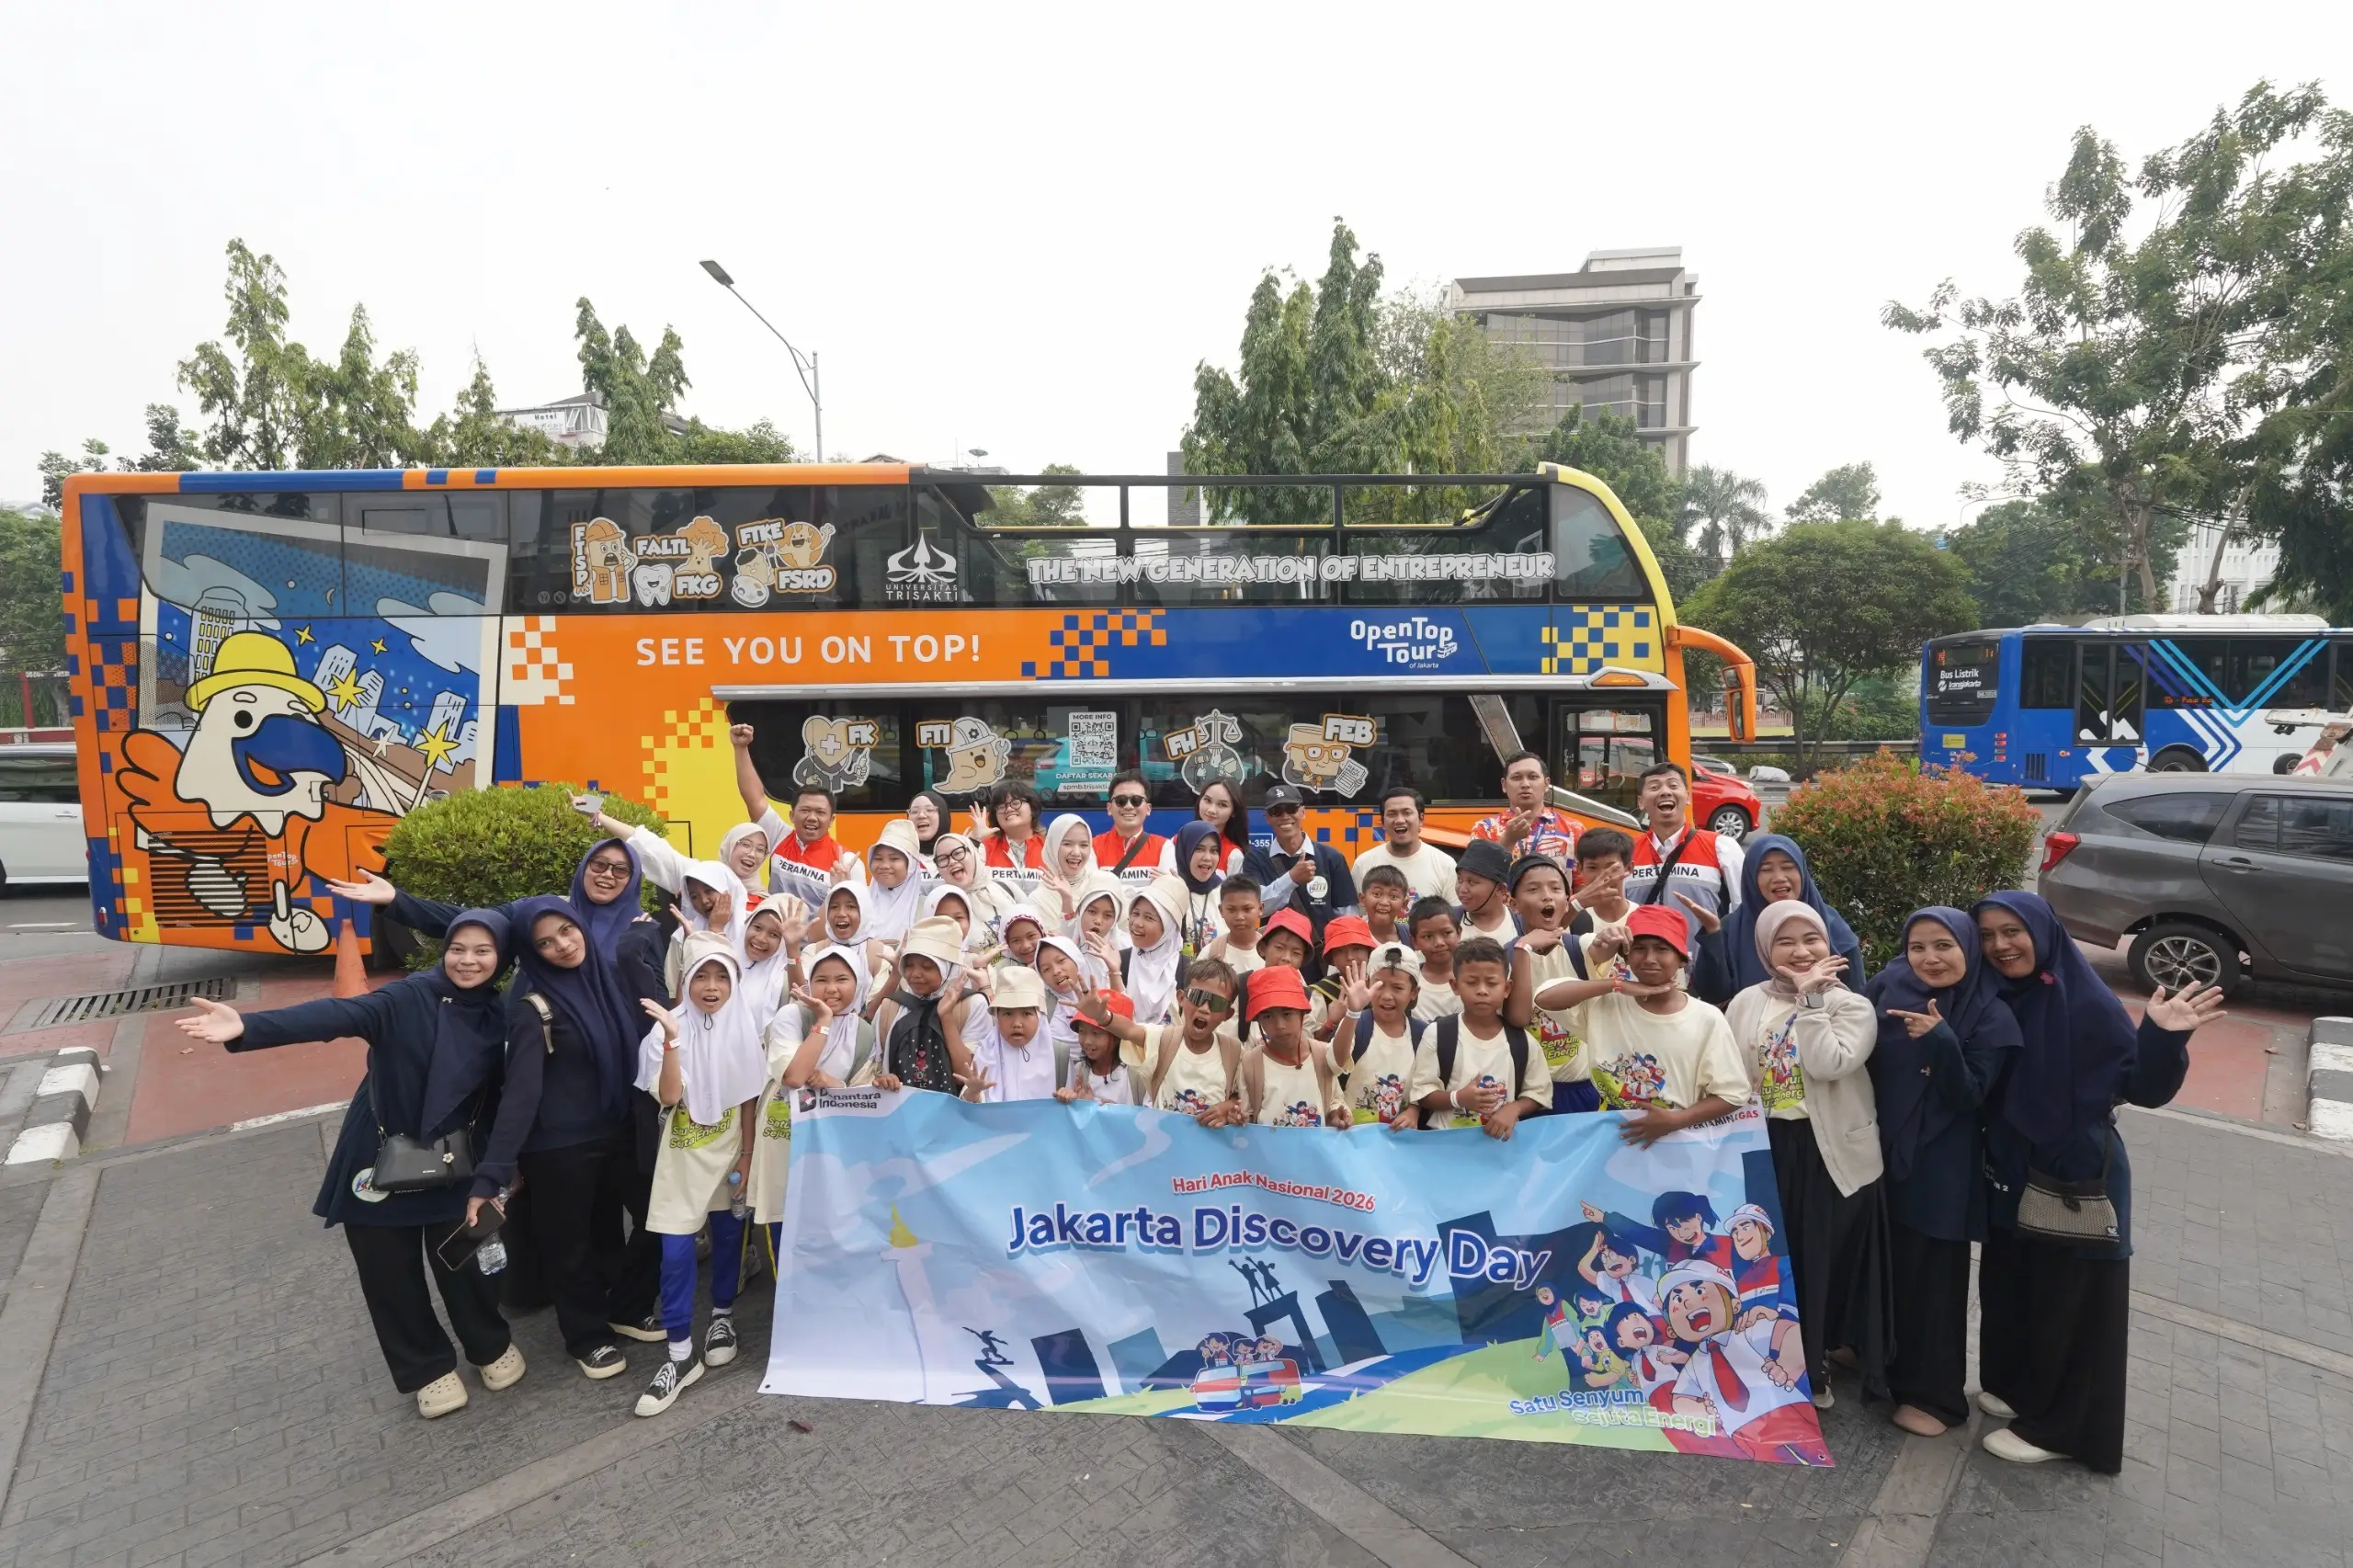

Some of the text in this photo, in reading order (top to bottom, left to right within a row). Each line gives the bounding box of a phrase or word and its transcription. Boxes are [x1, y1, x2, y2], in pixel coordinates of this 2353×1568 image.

[534, 413, 557, 421] Hotel
[739, 521, 784, 545] FTKE
[574, 526, 589, 585] FTSP
[637, 538, 692, 556] FALTL
[1028, 552, 1556, 584] THE NEW GENERATION OF ENTREPRENEUR
[676, 574, 718, 596] FKG
[778, 569, 833, 590] FSRD
[885, 591, 958, 601] TRISAKTI
[636, 634, 981, 666] SEE YOU ON TOP!
[1377, 642, 1437, 664] Tour
[1940, 668, 1979, 679] Bus Listrik
[1948, 680, 1982, 688] transjakarta
[847, 724, 875, 745] FK
[919, 723, 951, 745] FTI
[1324, 717, 1374, 745] FEB
[1166, 729, 1199, 757] FH
[1248, 839, 1270, 847] -355
[1632, 866, 1699, 879] PERTMINA
[819, 1087, 881, 1101] Dnantara
[819, 1098, 878, 1109] Indonesia
[1738, 1109, 1759, 1120] GAS
[1172, 1170, 1376, 1211] Hari Anak Nasional 2026
[1009, 1202, 1552, 1290] Jakarta Discovery Day
[1509, 1388, 1644, 1415] Satu Senyum
[1572, 1407, 1717, 1437] Sejuta Energi
